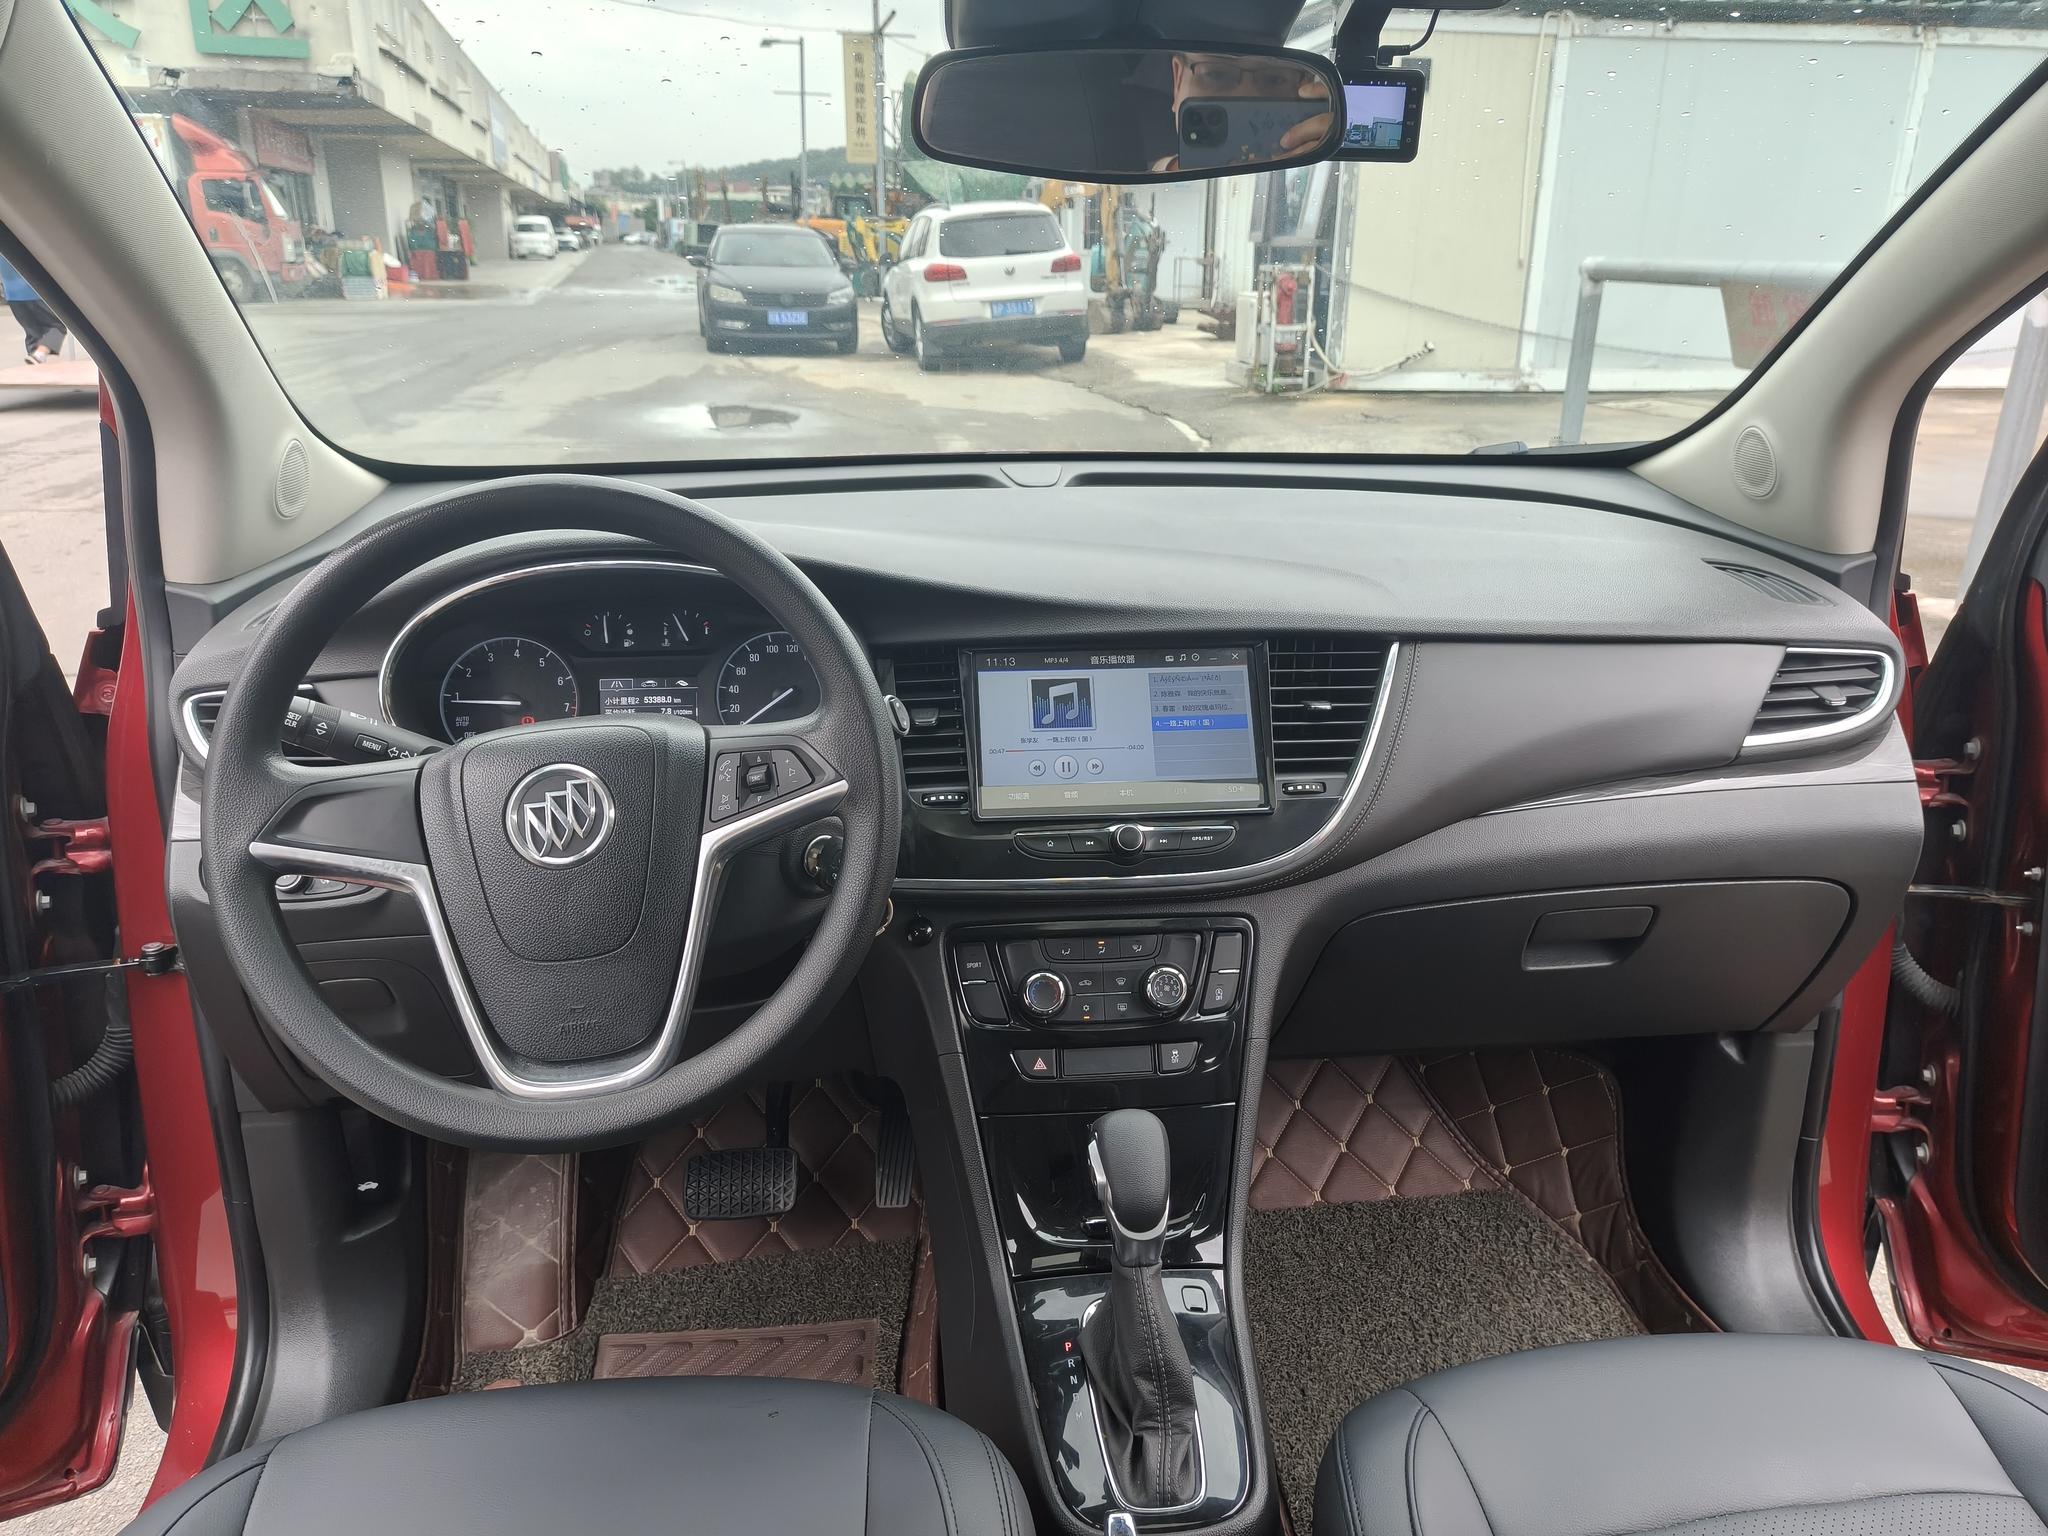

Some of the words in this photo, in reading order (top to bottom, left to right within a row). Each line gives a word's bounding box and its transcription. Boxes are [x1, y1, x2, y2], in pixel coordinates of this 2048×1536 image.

[766, 645, 779, 654] 100
[786, 644, 799, 653] 120
[488, 653, 494, 662] 3
[514, 649, 520, 658] 4
[750, 654, 760, 662] 80
[539, 658, 545, 667] 5
[986, 657, 1016, 668] 11:13
[1091, 655, 1135, 665] 音乐播放器
[466, 668, 472, 678] 2
[736, 667, 746, 676] 60
[558, 677, 563, 686] 6
[729, 685, 739, 694] 40
[564, 703, 570, 712] 7
[730, 704, 740, 713] 20
[284, 718, 298, 728] CLR
[362, 740, 382, 752] MENU
[1065, 1342, 1072, 1352] P
[1068, 1359, 1075, 1368] R
[1070, 1375, 1078, 1385] N
